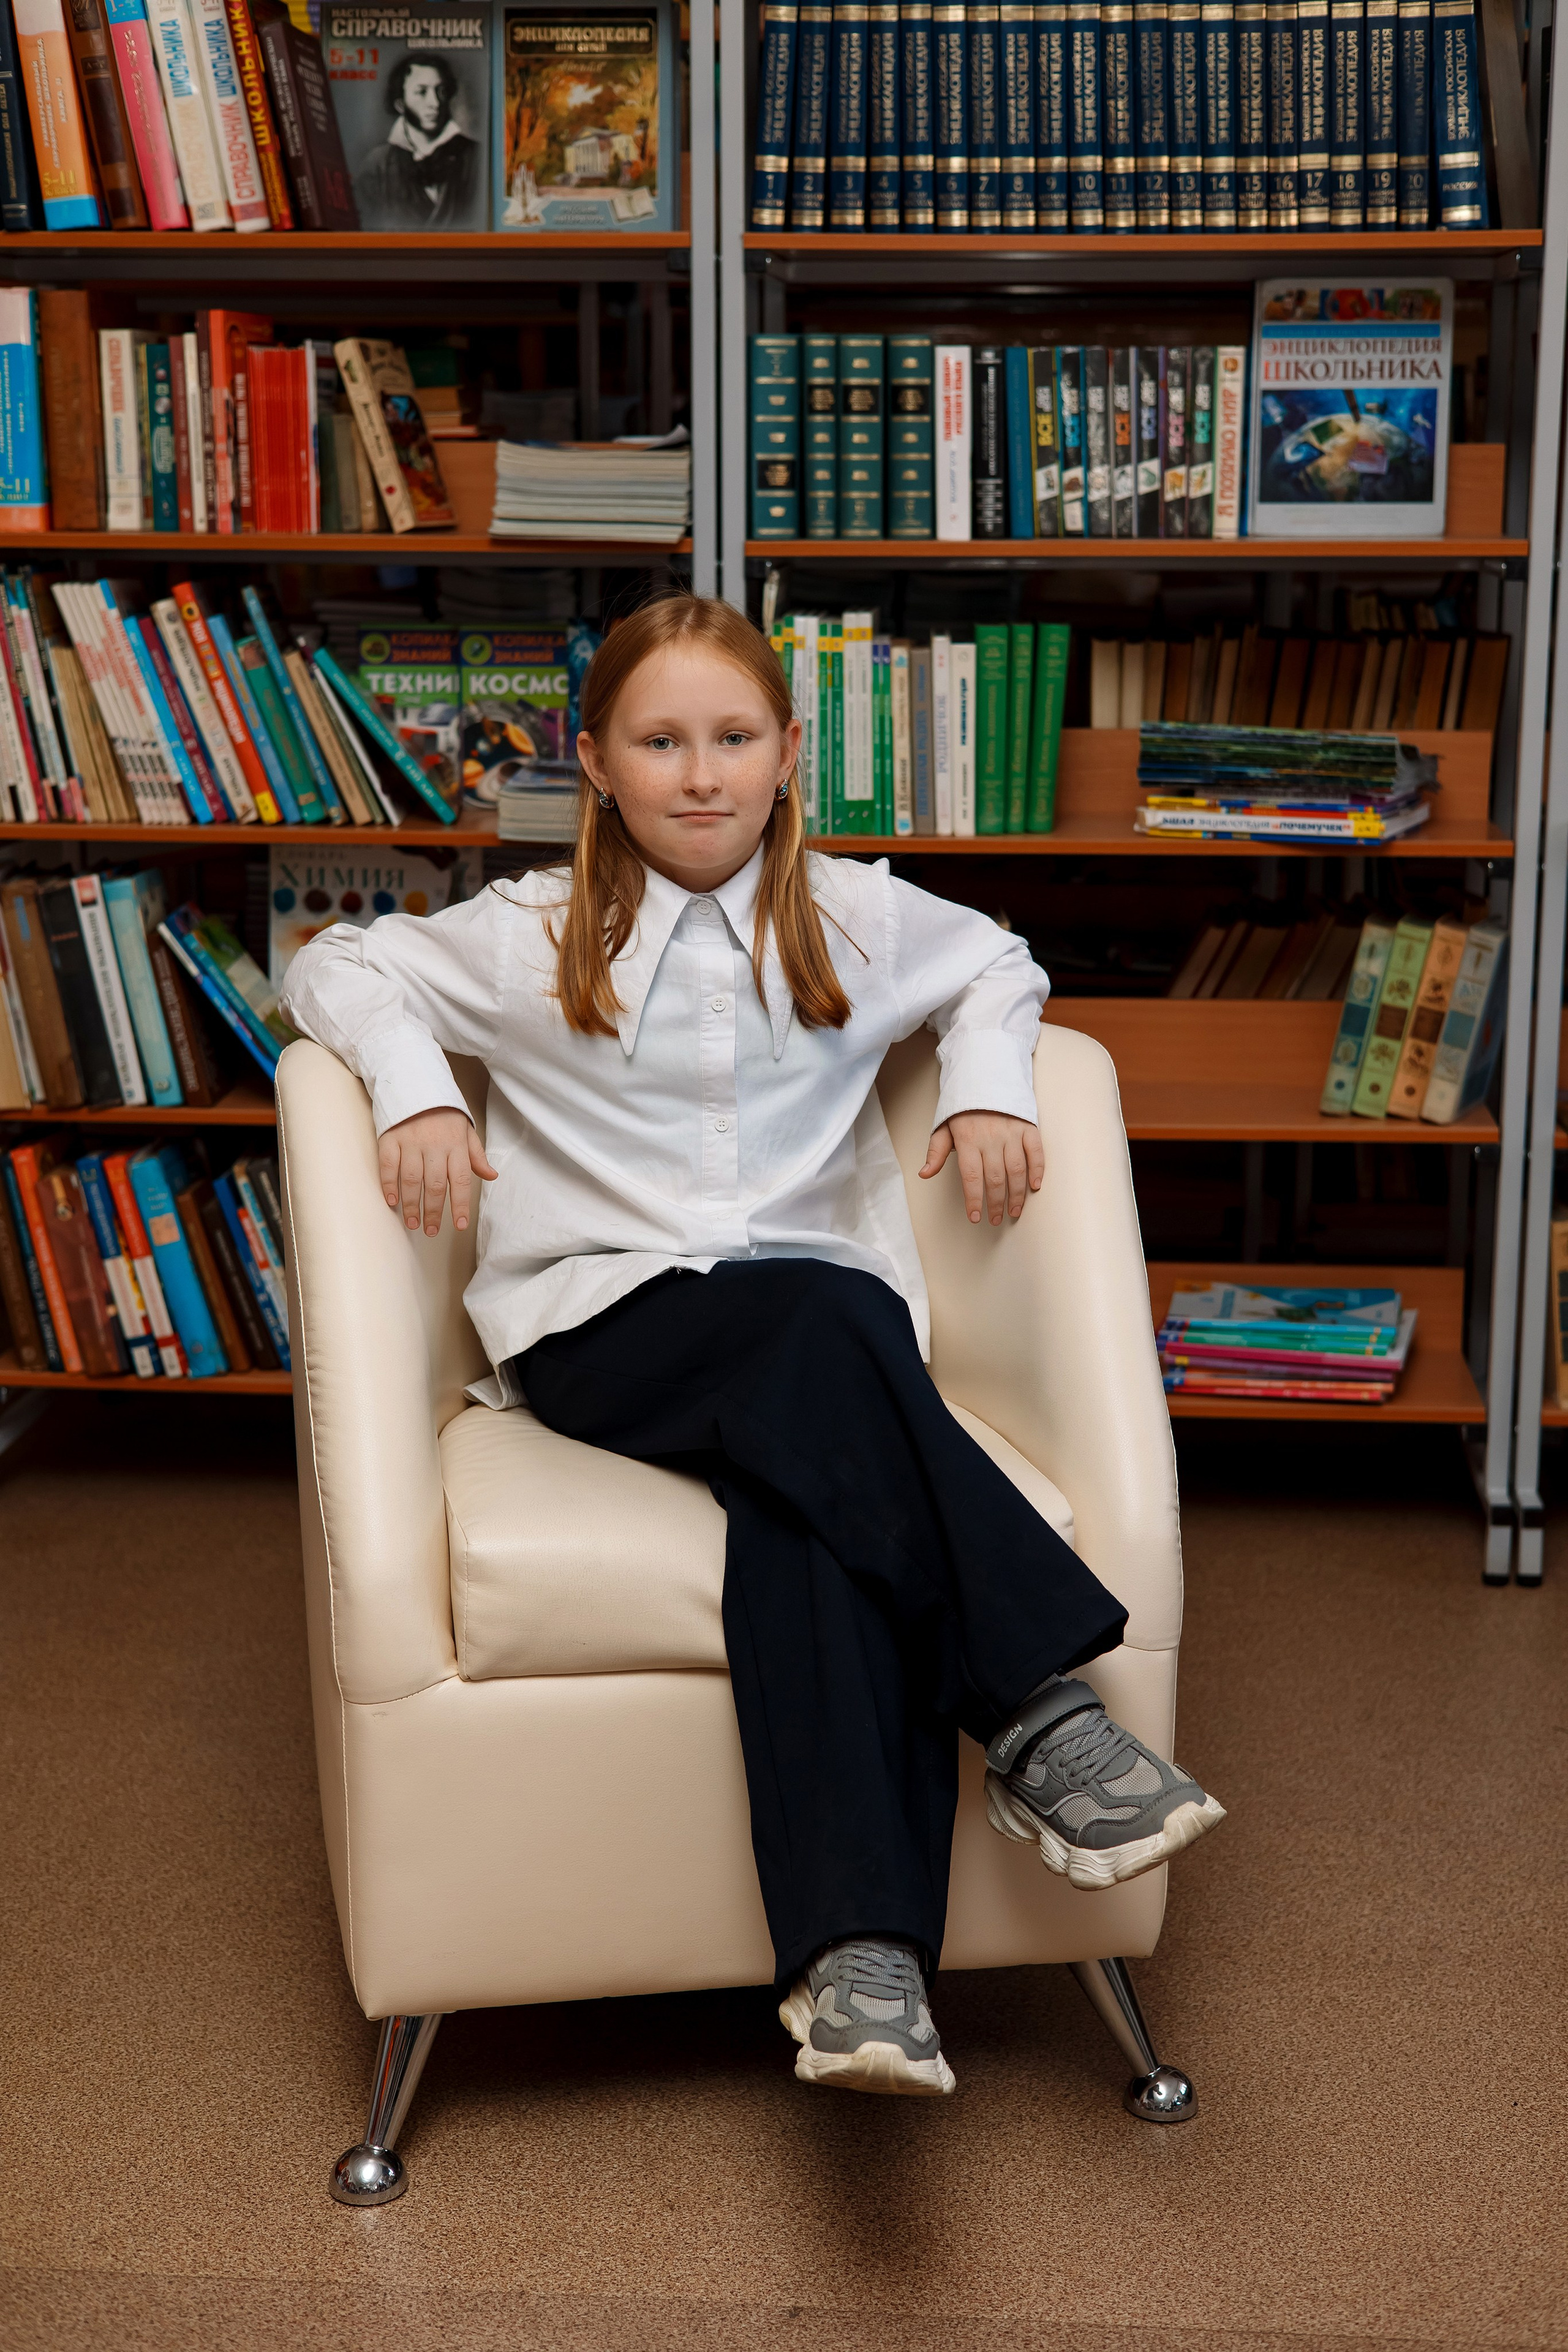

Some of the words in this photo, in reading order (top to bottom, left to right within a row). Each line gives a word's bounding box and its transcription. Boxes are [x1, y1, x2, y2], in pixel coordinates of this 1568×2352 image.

[331, 18, 483, 37] СПРАВОЧНИК
[513, 26, 650, 42] ЭНЦИКЛОПЕДИЯ
[160, 18, 192, 98] ШКОЛЬНИКА
[203, 18, 237, 97] ШКОЛЬНИКА
[1444, 30, 1455, 92] РОССИЙСКАЯ
[228, 0, 271, 146] ШКОЛЬНИК
[1250, 32, 1262, 143] ЭНЦИКЛОПЕДИЯ
[1281, 32, 1294, 143] ЭНЦИКЛОПЕДИЯ
[1313, 29, 1324, 139] ЭНЦИКЛОПЕДИЯ
[1346, 31, 1358, 141] ЭНЦИКЛОПЕДИЯ
[1381, 28, 1393, 138] ЭНЦИКЛОПЕДИЯ
[1455, 29, 1470, 139] ЭНЦИКЛОПЕДИЯ
[219, 99, 256, 200] СПРАВОЧНИК
[766, 175, 774, 189] 1
[804, 176, 813, 191] 2
[947, 176, 957, 190] 6
[979, 176, 989, 191] 7
[1014, 176, 1023, 192] 8
[1046, 176, 1057, 190] 9
[1079, 173, 1095, 190] 10
[1110, 176, 1126, 191] 11
[1146, 175, 1163, 190] 12
[1177, 175, 1195, 190] 13
[1212, 175, 1228, 190] 14
[1245, 175, 1261, 190] 15
[1276, 174, 1294, 190] 16
[1306, 172, 1324, 188] 17
[1340, 172, 1355, 189] 18
[1375, 171, 1390, 189] 19
[1264, 338, 1442, 355] ЭНЦИКЛОПЕДИЯ
[1264, 358, 1442, 381] ШКОЛЬНИКА
[1223, 388, 1238, 425] МИР
[1219, 429, 1237, 499] ПОЗНАЮ
[998, 1723, 1023, 1758] DESIGN
